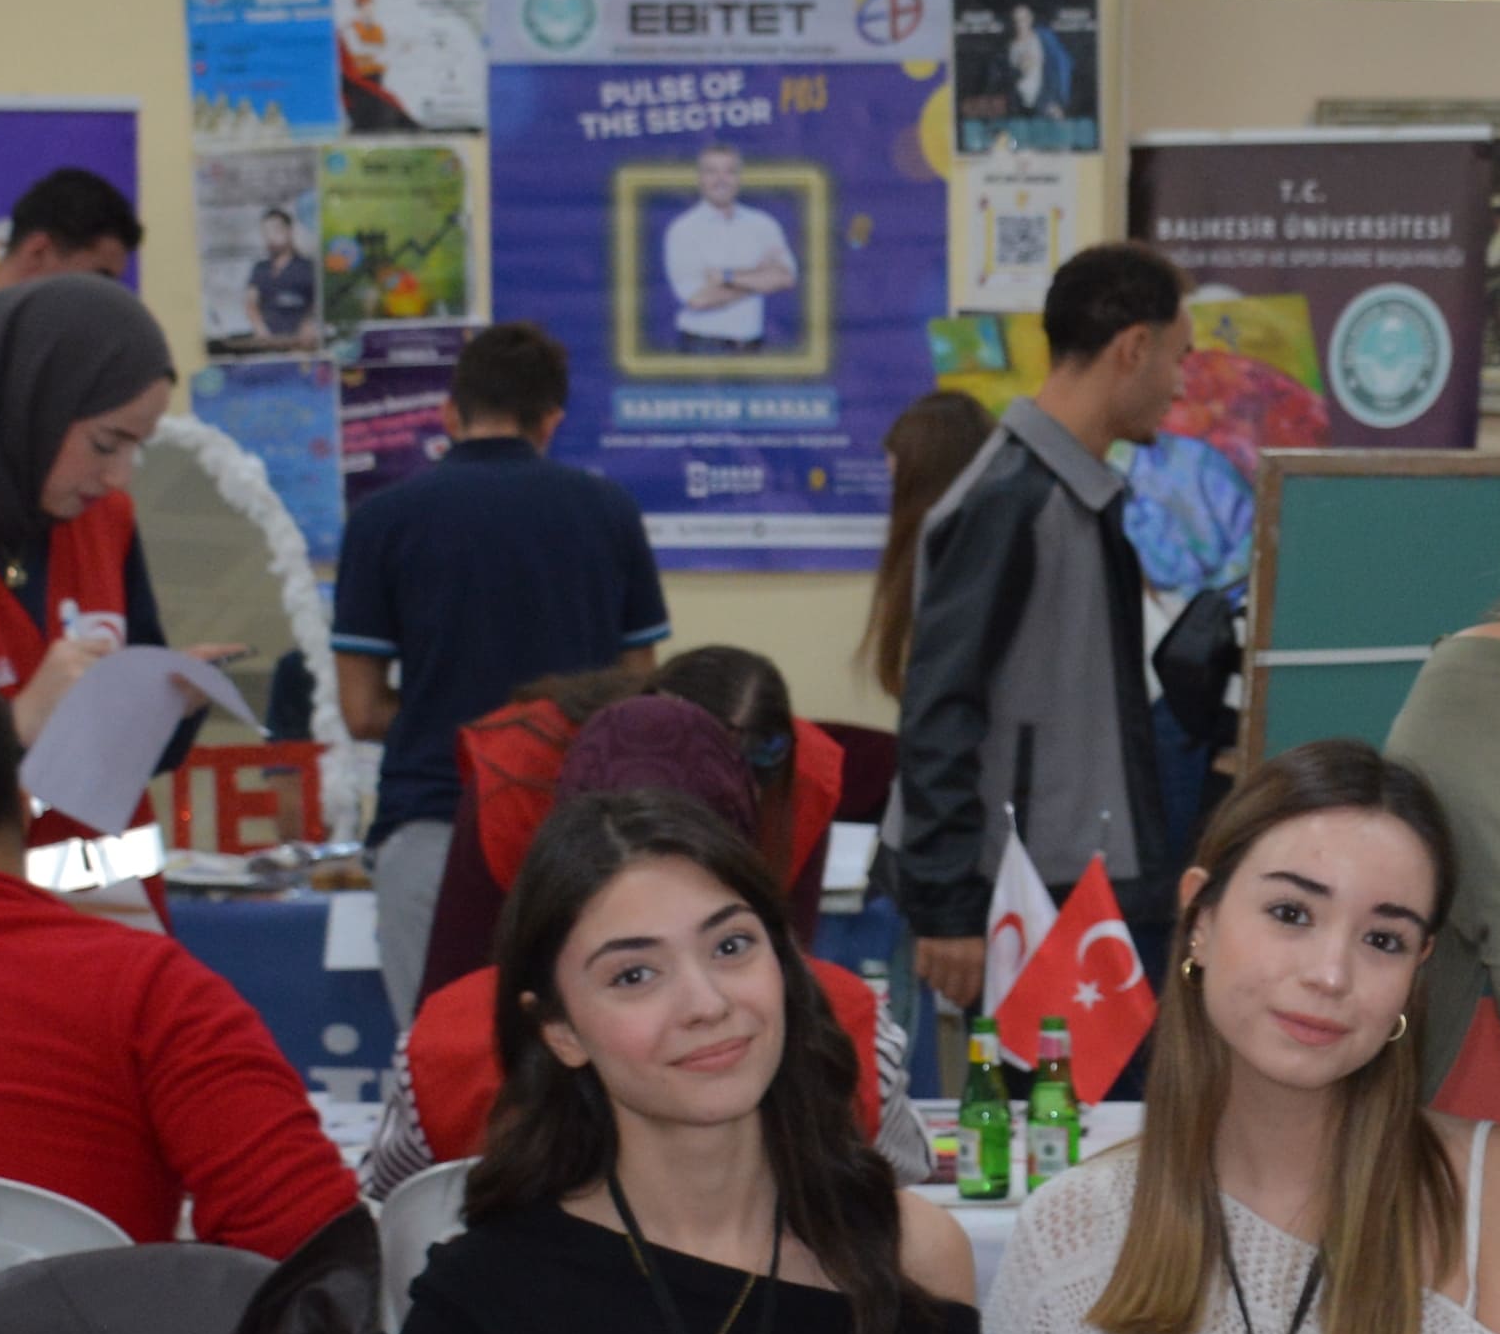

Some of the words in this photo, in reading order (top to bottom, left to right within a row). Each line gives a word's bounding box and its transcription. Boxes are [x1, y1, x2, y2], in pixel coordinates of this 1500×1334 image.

[601, 76, 696, 108] PULSE
[703, 71, 746, 100] OF
[579, 111, 642, 141] THE
[646, 98, 772, 136] SECTOR
[1280, 177, 1326, 205] T.C.
[1156, 215, 1277, 241] BALIKESİR
[1283, 212, 1452, 240] ÜNİVERSİTESİ
